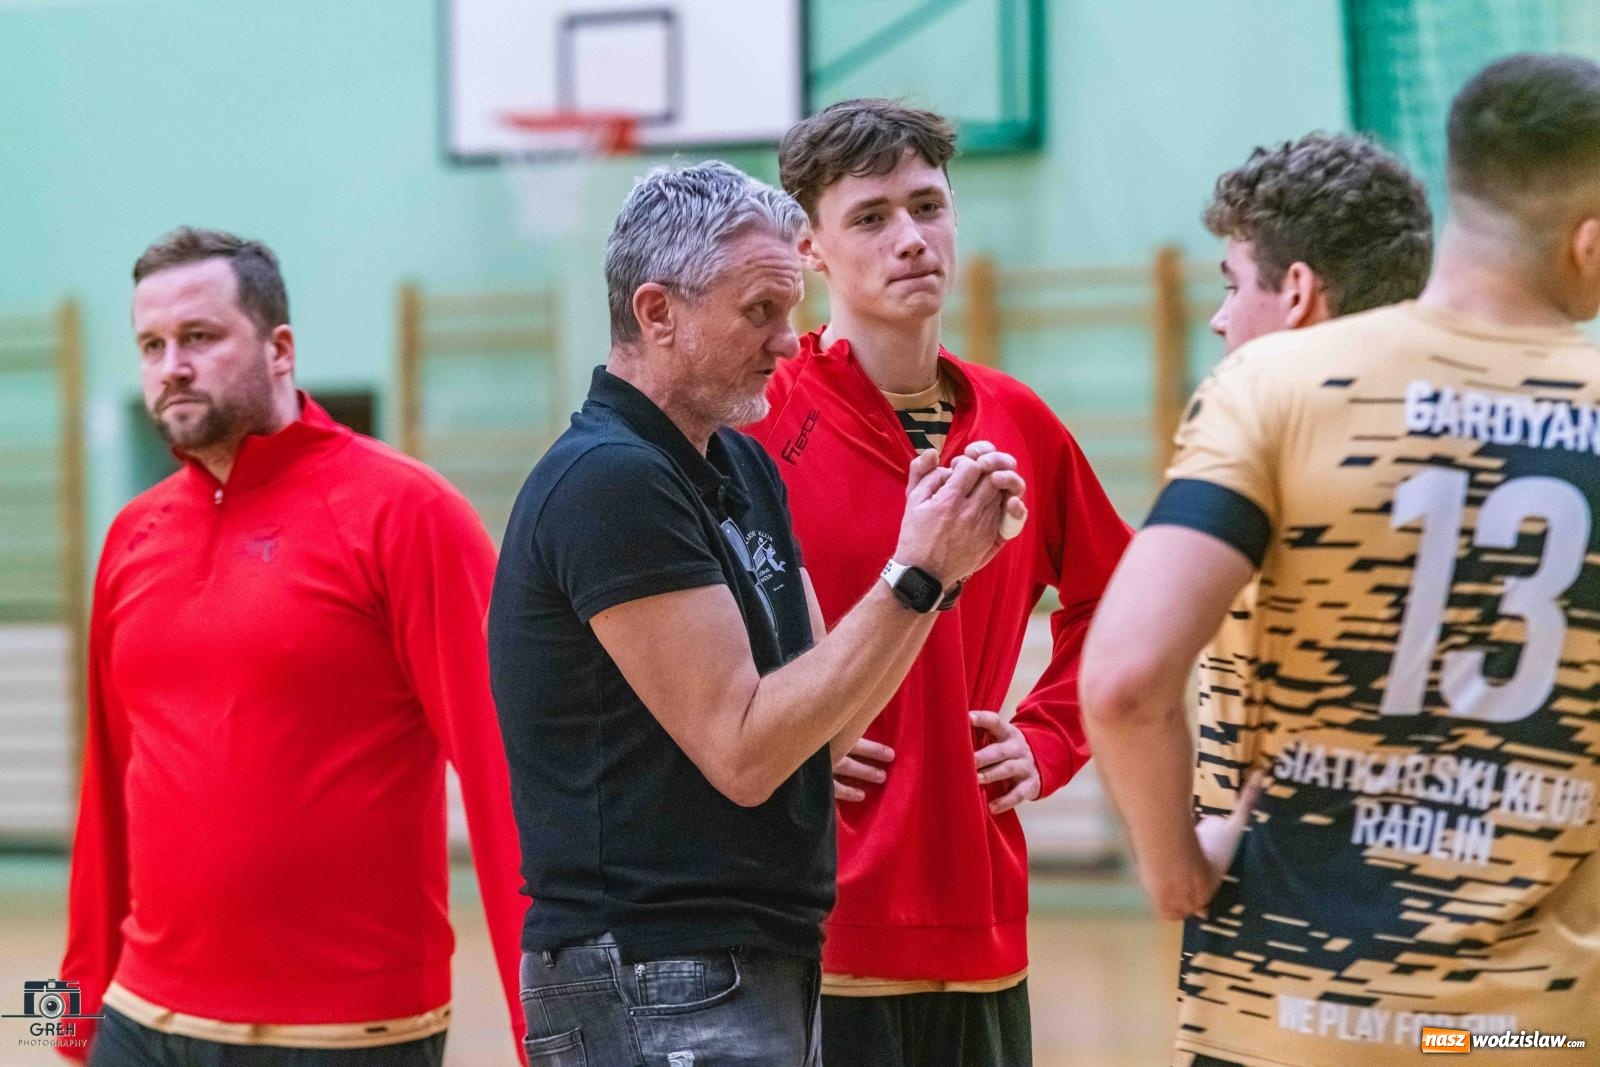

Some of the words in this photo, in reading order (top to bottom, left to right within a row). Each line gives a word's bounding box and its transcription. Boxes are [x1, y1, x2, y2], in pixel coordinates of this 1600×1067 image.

[1379, 467, 1592, 724] 13
[1273, 741, 1498, 810] SIATKARSKI
[1501, 764, 1595, 826] KLUB
[1351, 797, 1496, 866] RADLIN
[1318, 1001, 1391, 1044] PLAY
